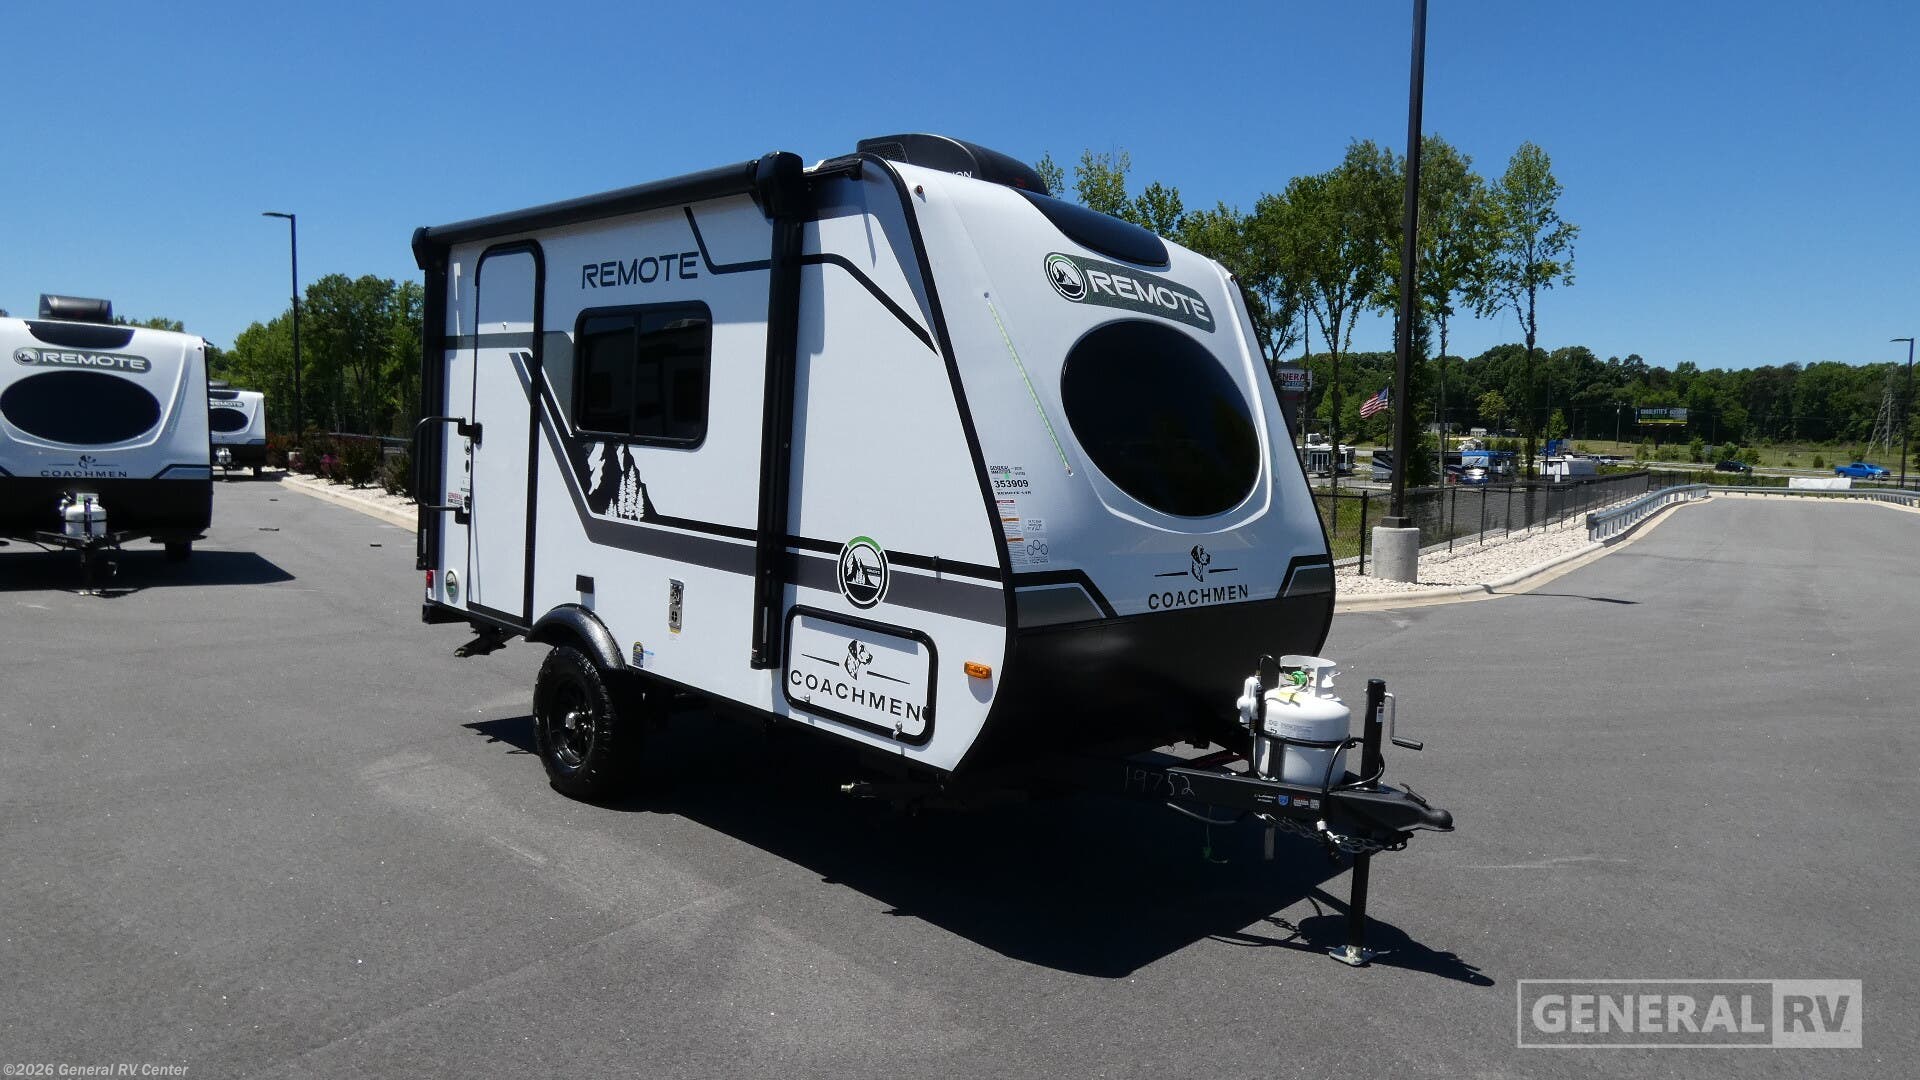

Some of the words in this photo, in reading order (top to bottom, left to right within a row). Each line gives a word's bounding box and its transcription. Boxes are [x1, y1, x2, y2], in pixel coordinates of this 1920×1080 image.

[582, 251, 699, 289] REMOTE
[1086, 269, 1210, 323] REMOTE
[42, 352, 146, 370] REMOTE
[40, 470, 127, 478] COACHMEN
[993, 480, 1029, 488] 353909
[1148, 584, 1249, 610] COACHMEN
[790, 669, 920, 722] COACHMEN
